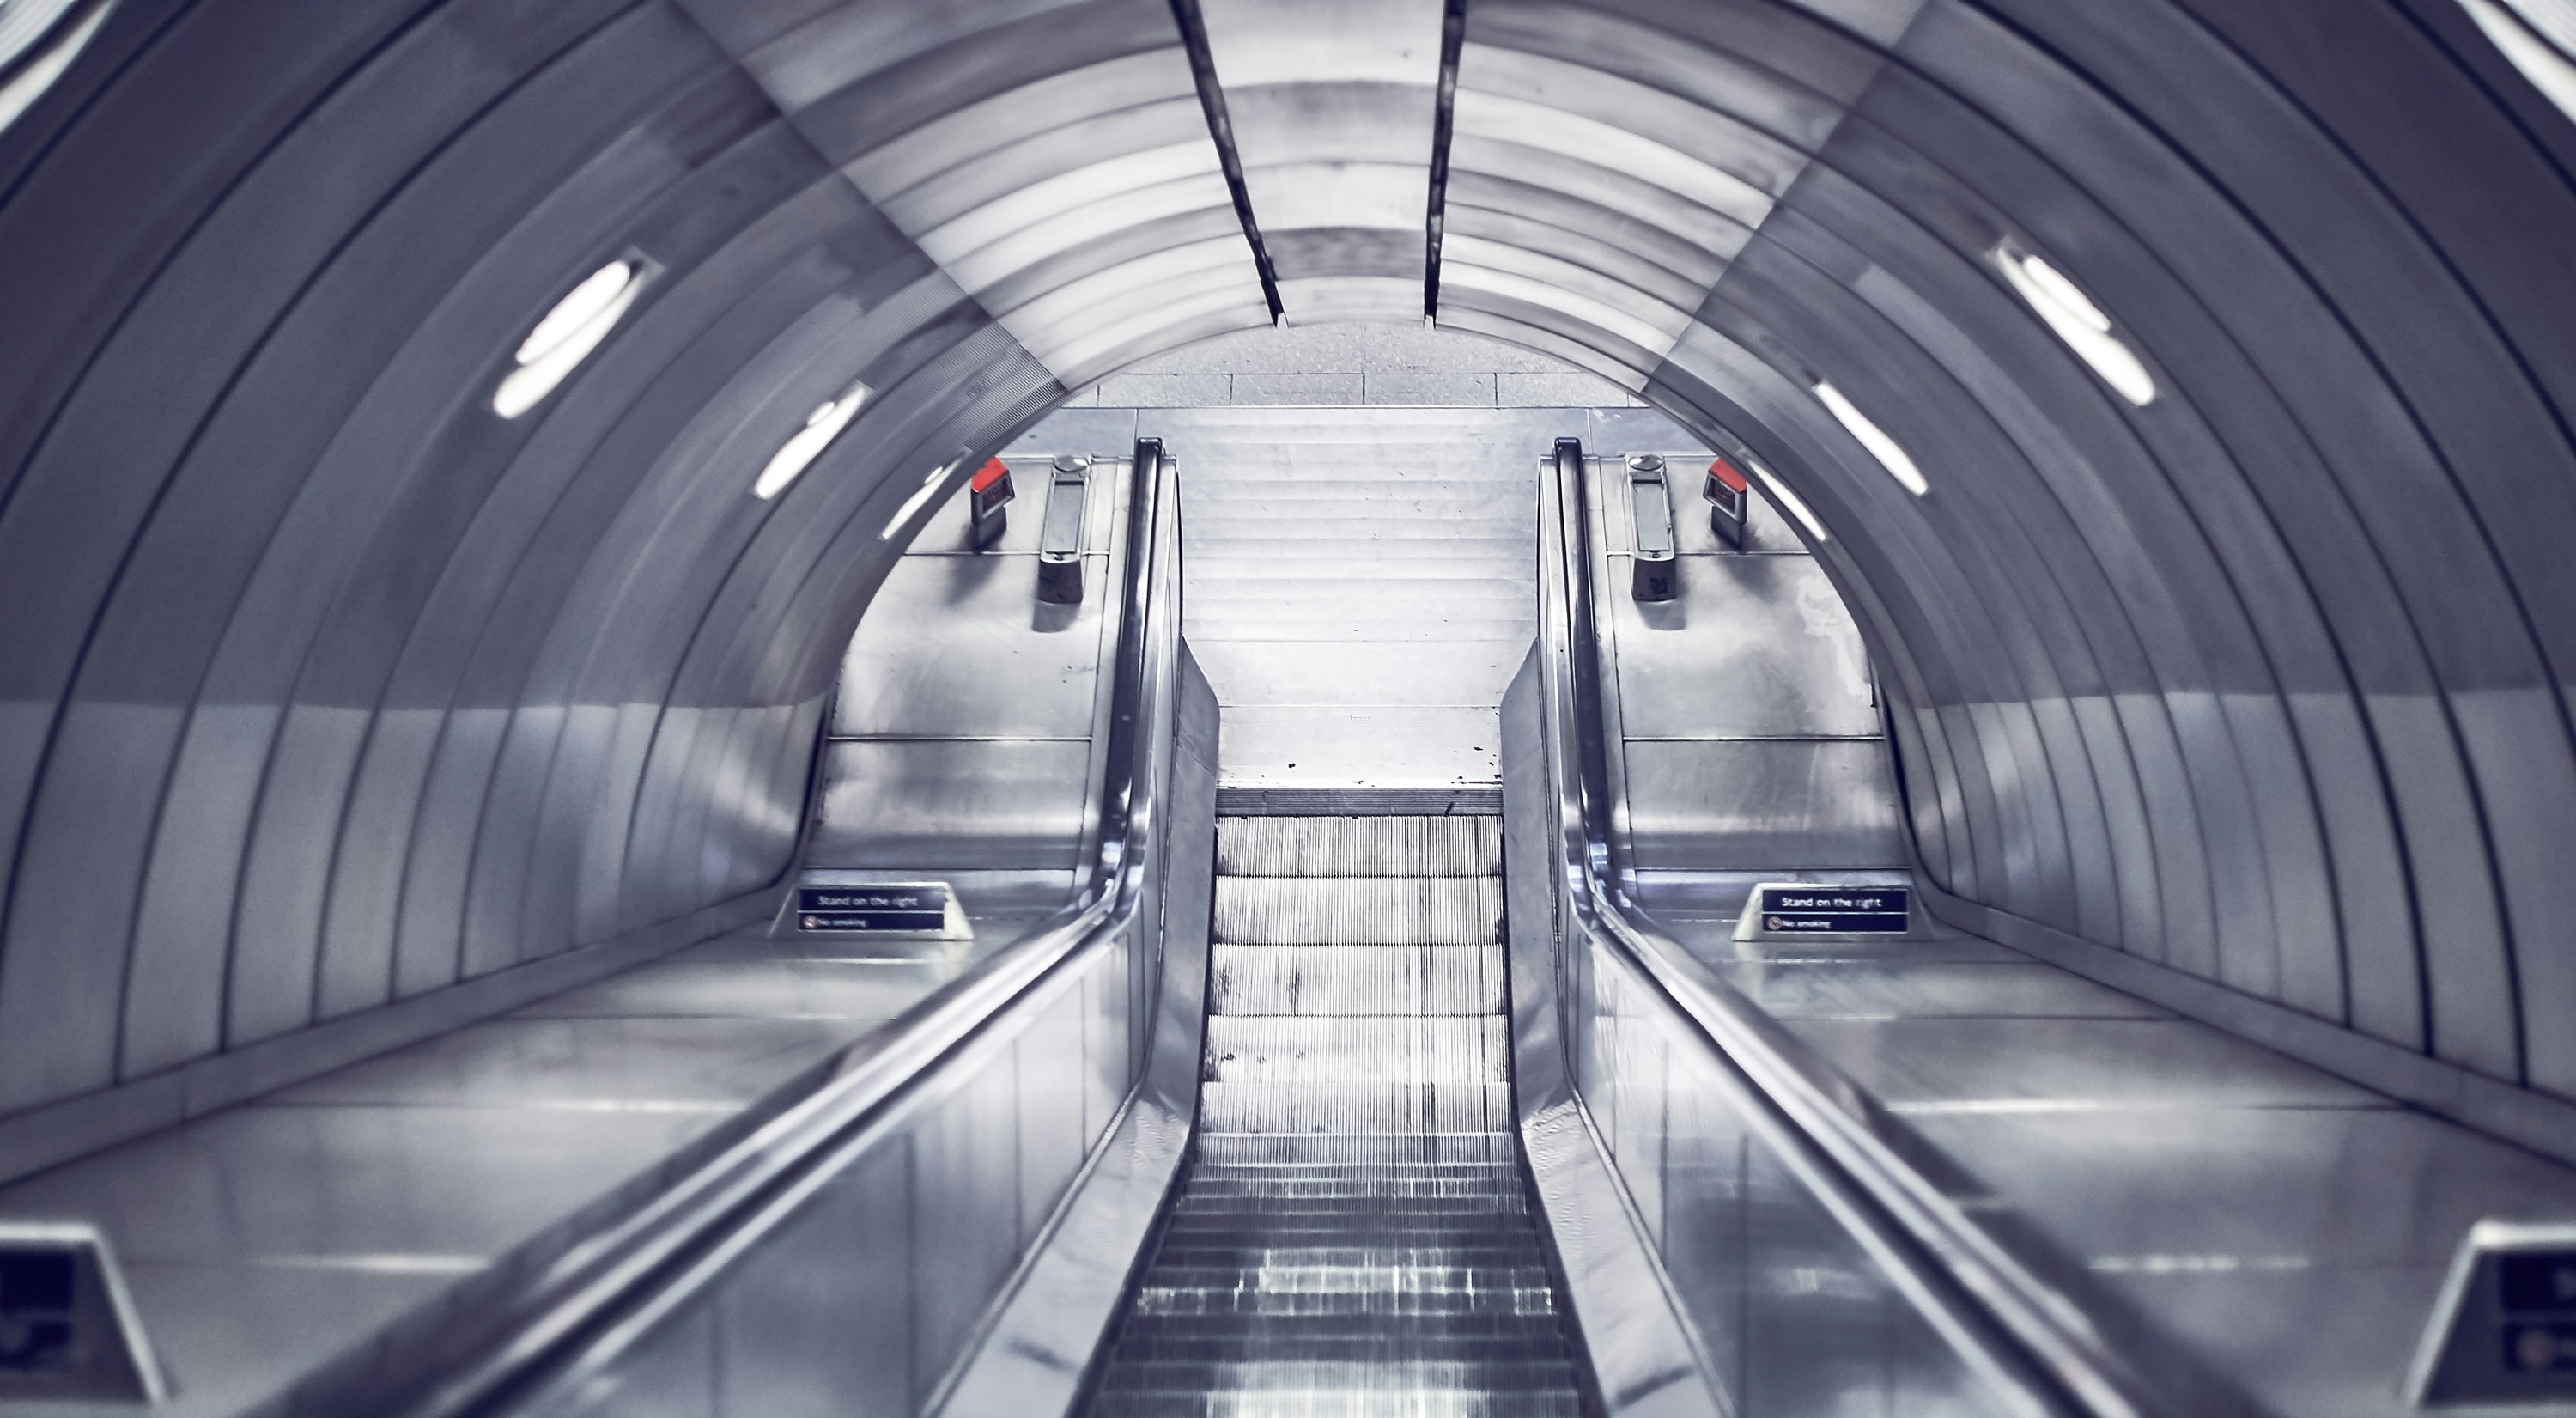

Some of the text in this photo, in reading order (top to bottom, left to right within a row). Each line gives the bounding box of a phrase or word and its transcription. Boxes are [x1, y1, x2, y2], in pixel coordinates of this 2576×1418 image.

[818, 896, 918, 909] Stand on the right
[1782, 897, 1881, 909] Stand on the right
[1797, 920, 1831, 929] smoking
